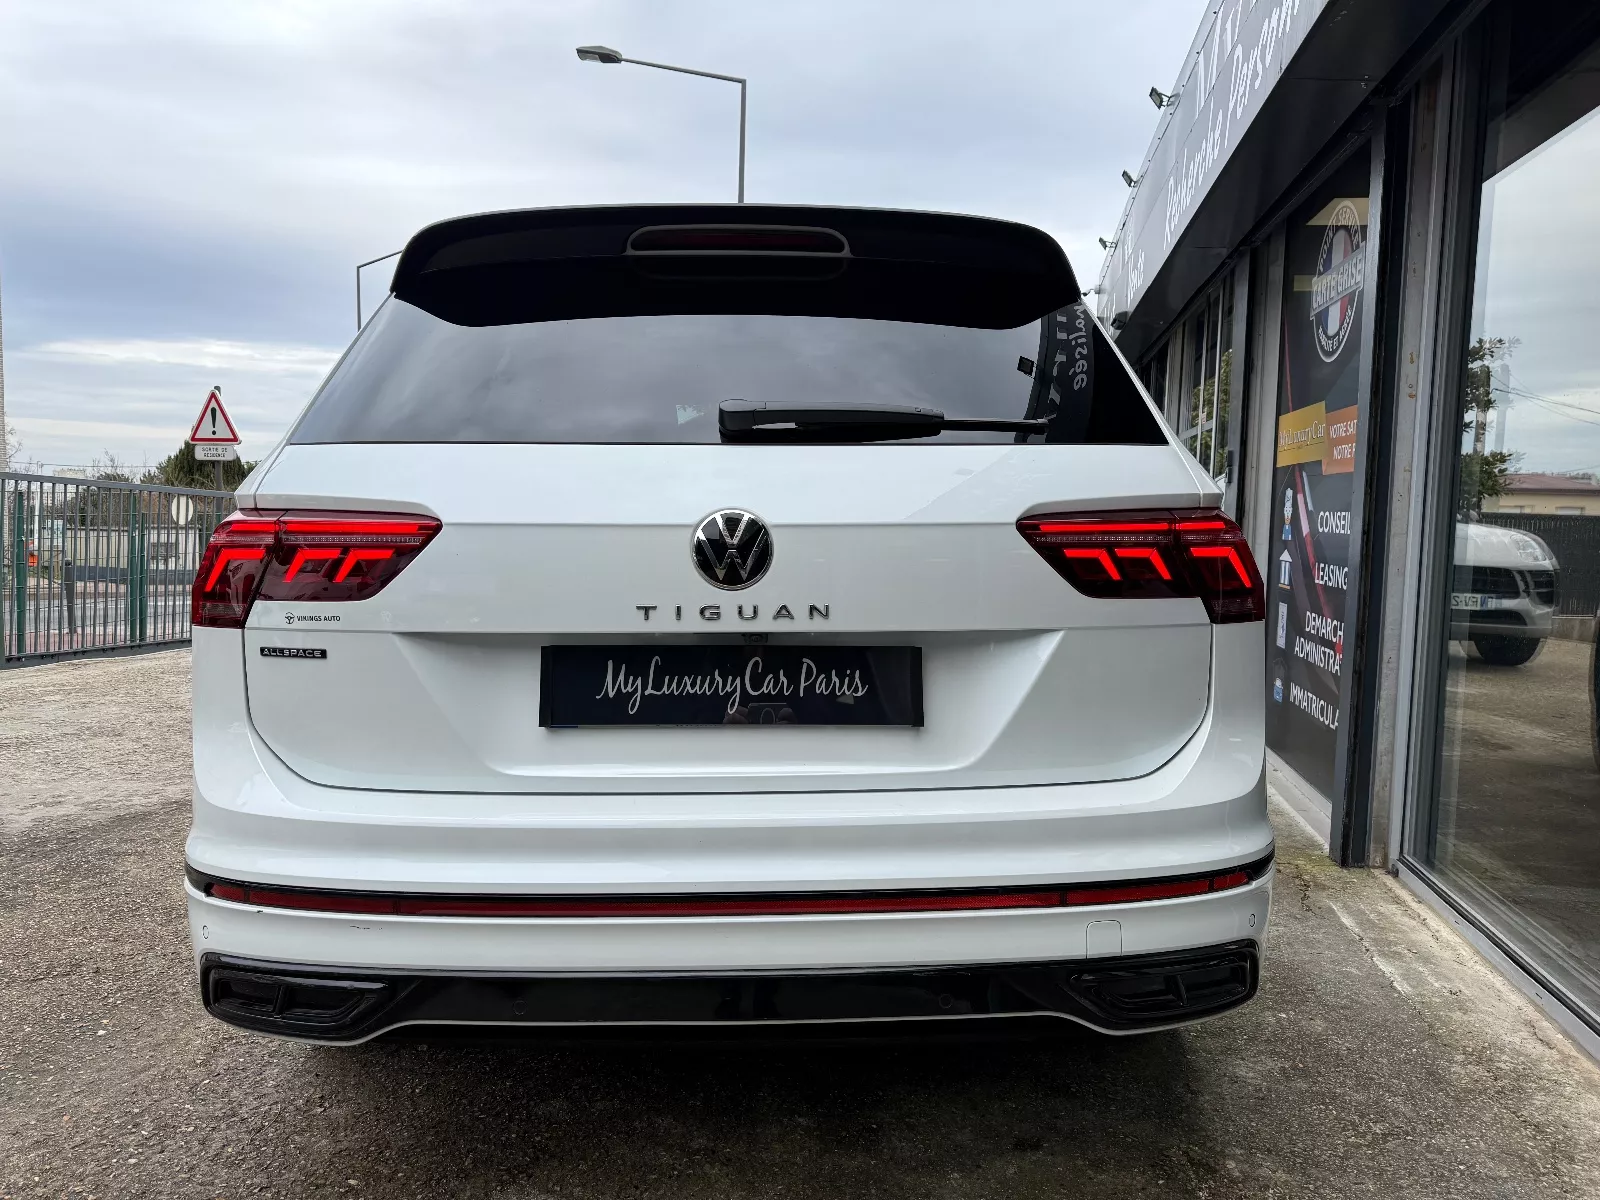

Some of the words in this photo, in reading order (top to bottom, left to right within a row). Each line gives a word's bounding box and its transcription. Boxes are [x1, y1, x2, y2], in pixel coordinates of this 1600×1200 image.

[1313, 272, 1337, 309] CARTE
[1338, 252, 1362, 293] GRISE
[1329, 422, 1347, 439] VOTRE
[1333, 444, 1352, 460] NOTRE
[1318, 511, 1351, 535] CONSEIL
[1314, 562, 1349, 590] LEASING
[635, 603, 830, 621] TIGUAN
[1305, 611, 1344, 645] DEMARCH
[262, 648, 322, 658] ALLSPACE
[799, 657, 869, 698] Paris
